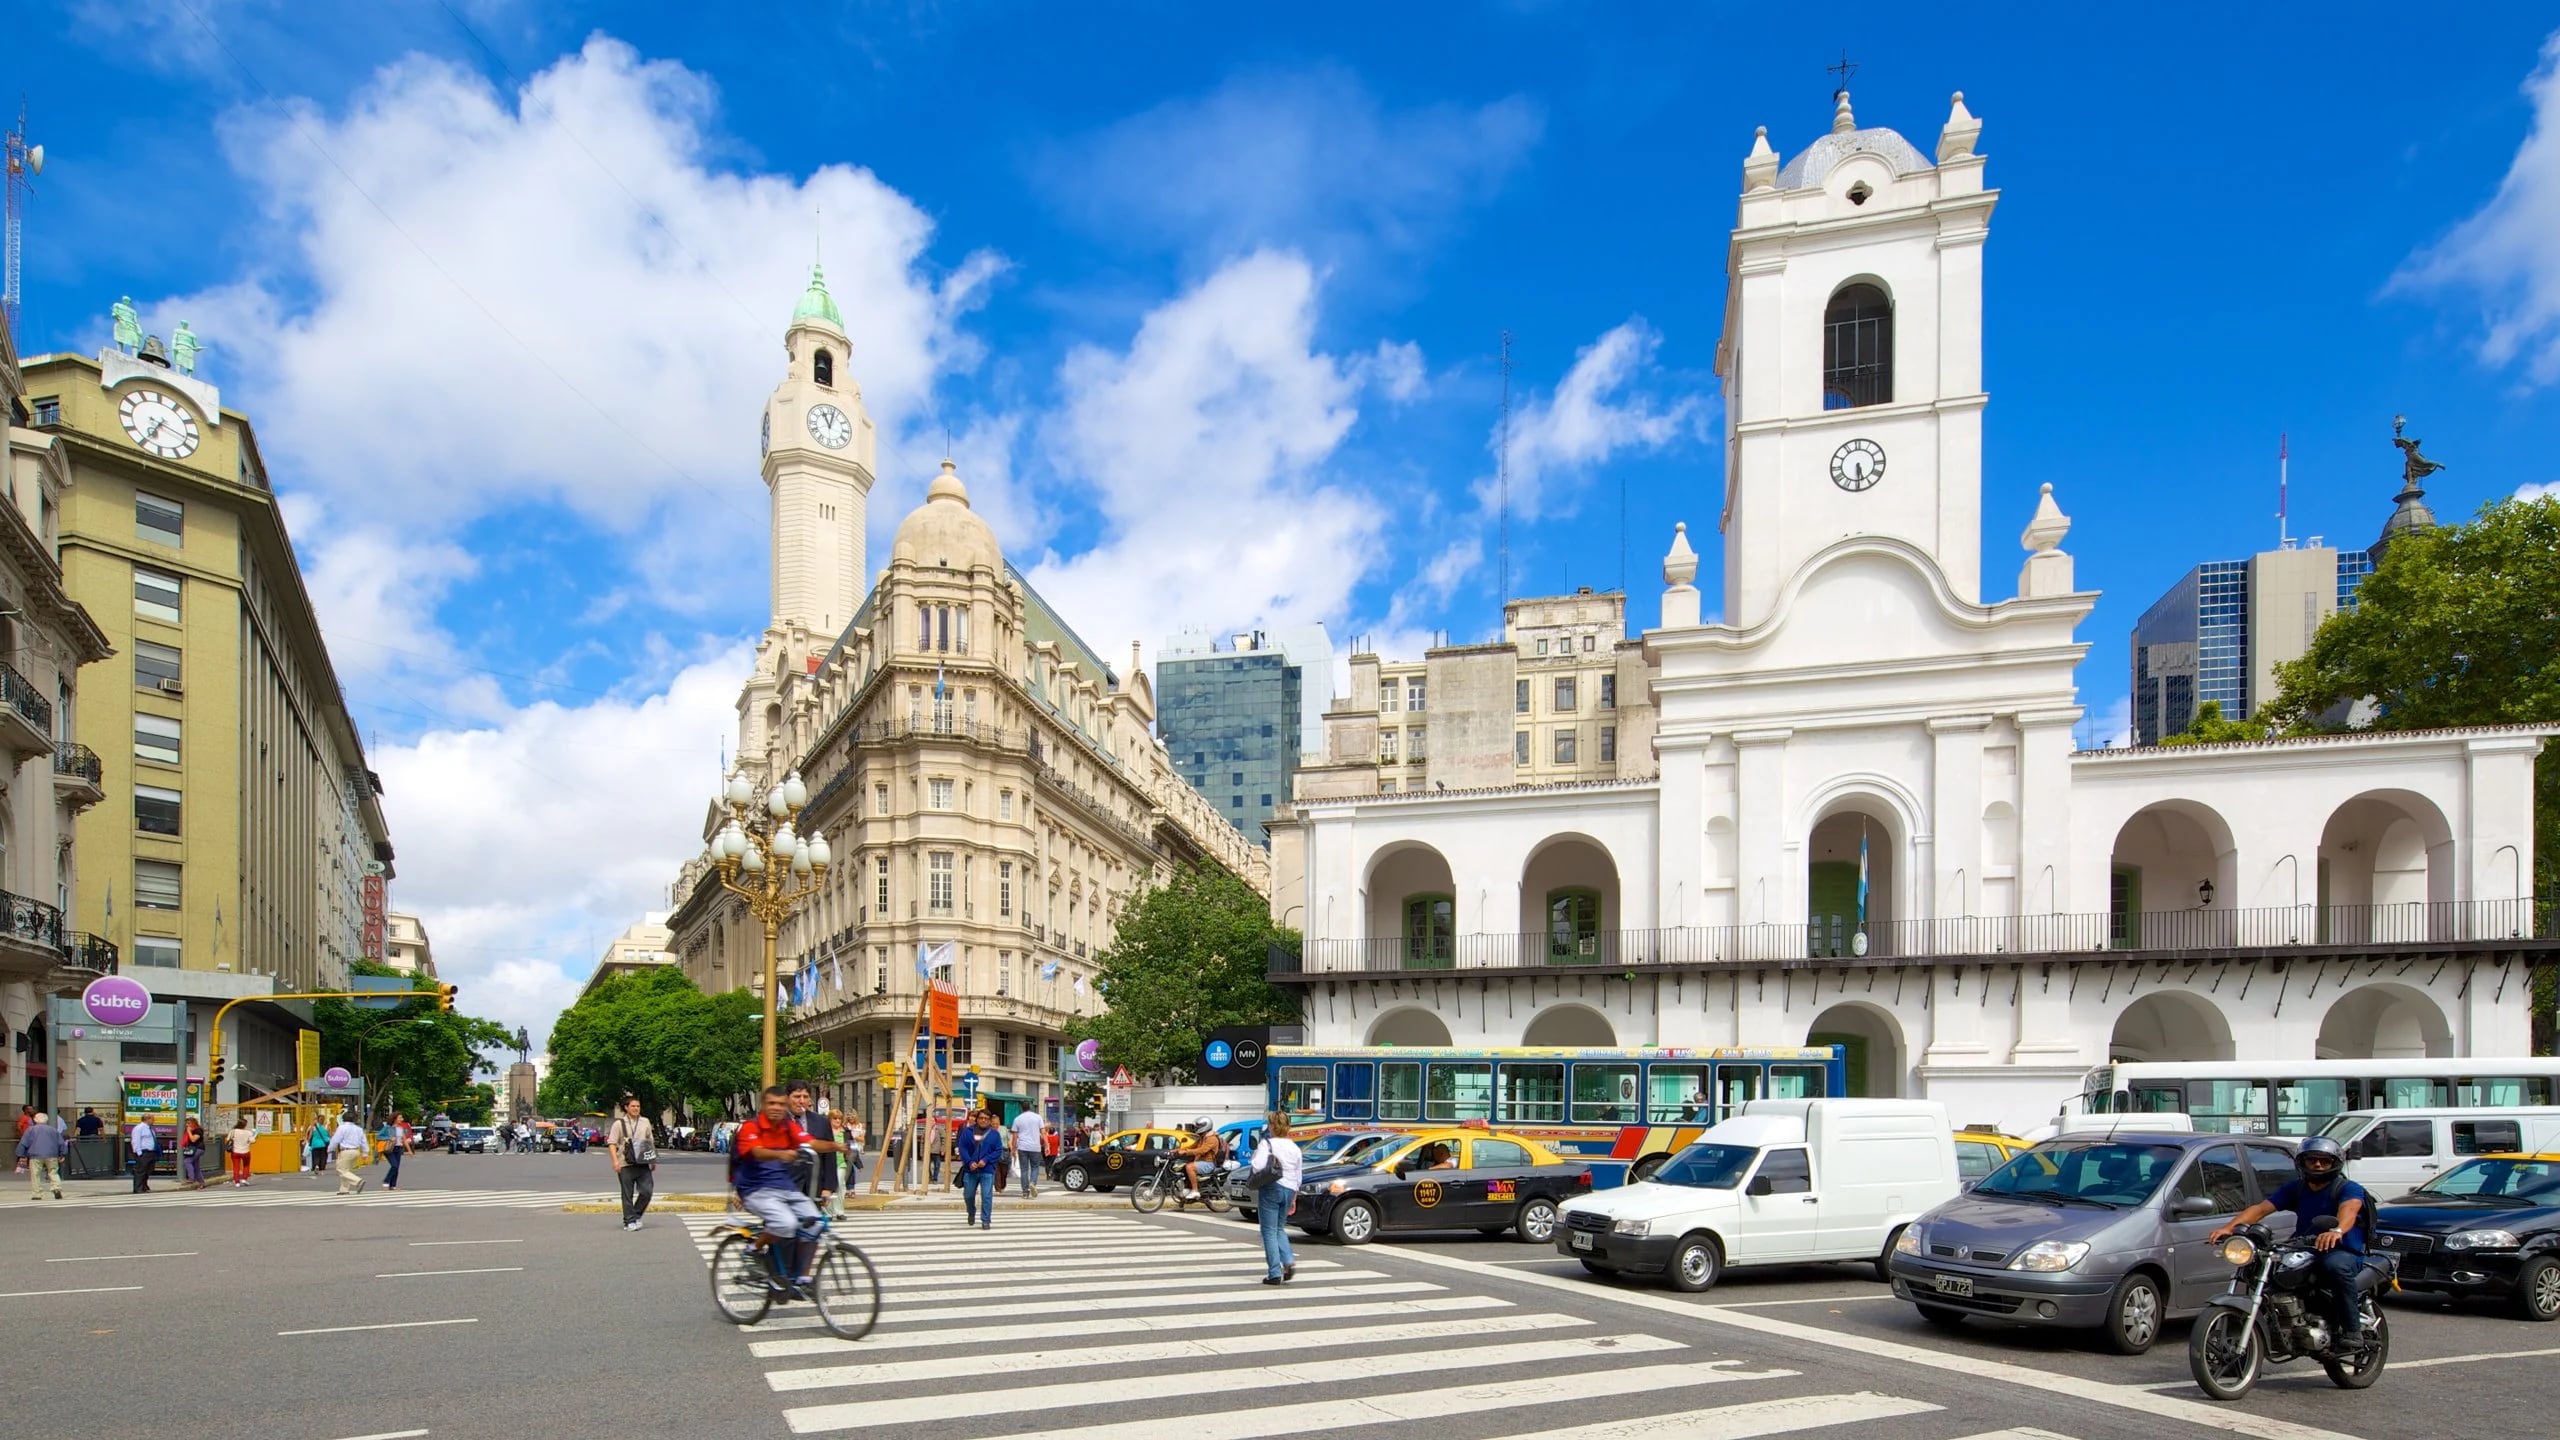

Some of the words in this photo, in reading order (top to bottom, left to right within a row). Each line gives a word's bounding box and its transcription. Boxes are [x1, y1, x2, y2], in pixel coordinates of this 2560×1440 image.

[90, 993, 142, 1010] Subte
[1239, 1050, 1256, 1058] MN
[1956, 1280, 1971, 1294] 723
